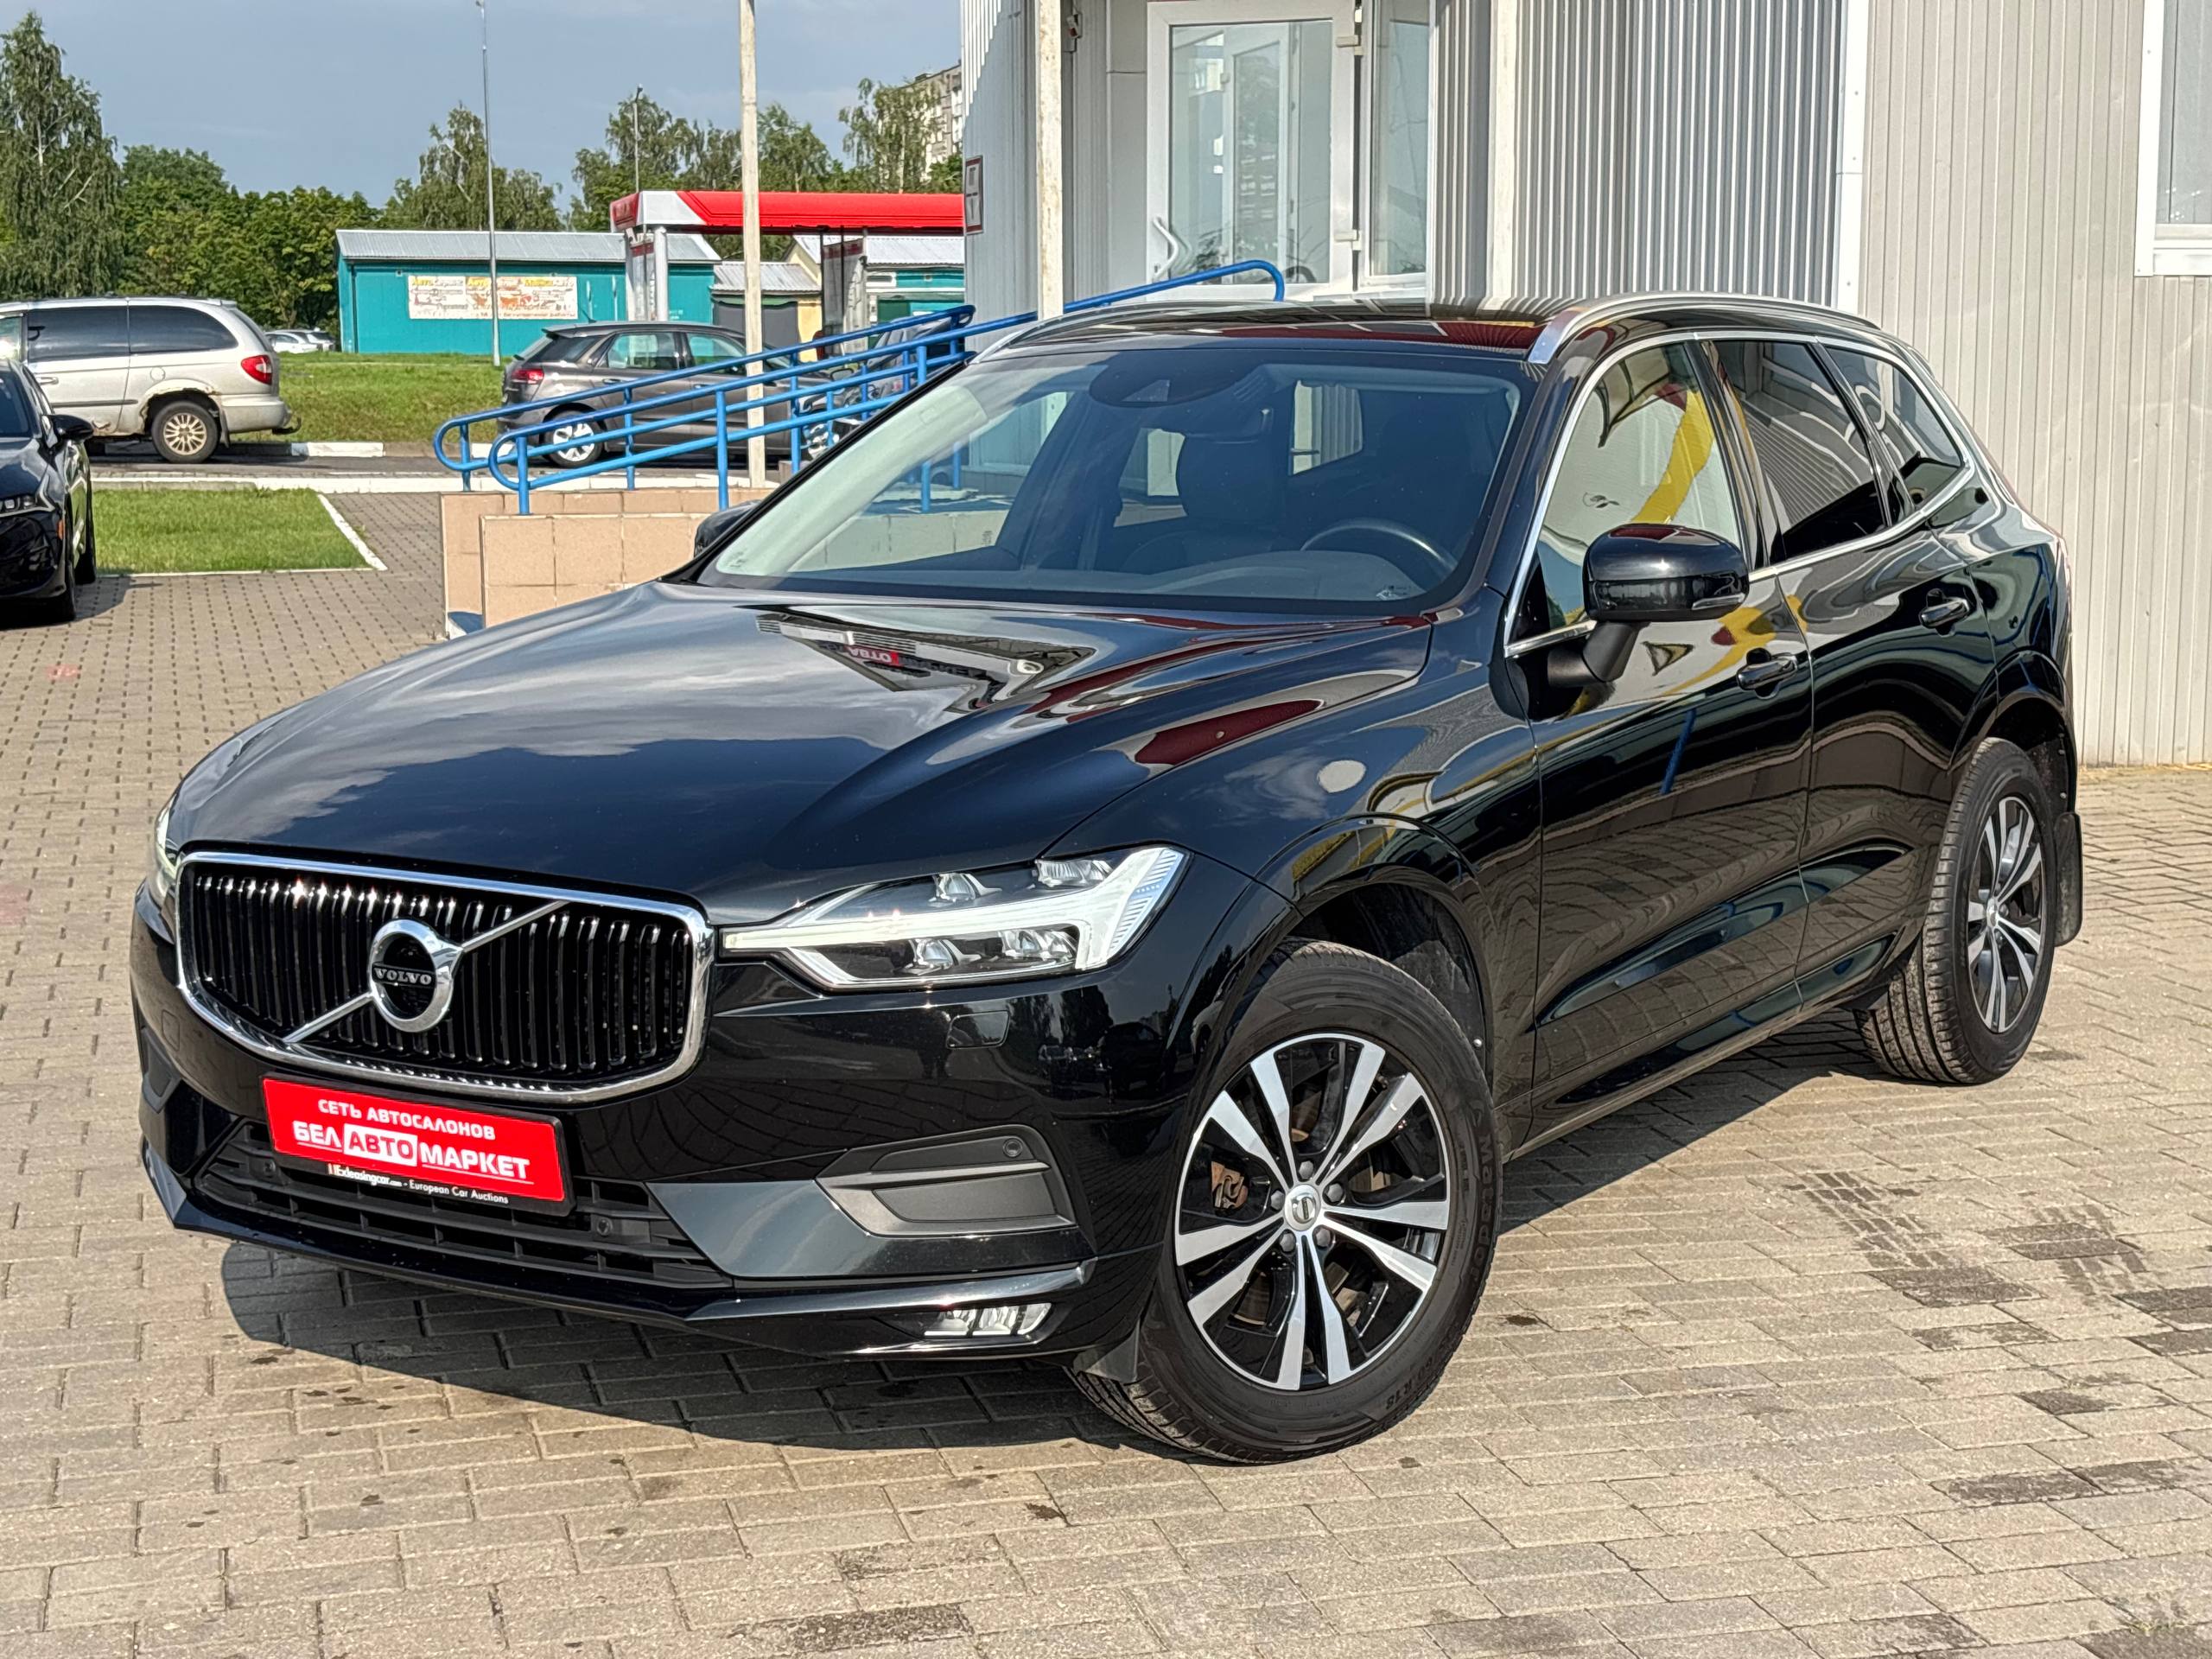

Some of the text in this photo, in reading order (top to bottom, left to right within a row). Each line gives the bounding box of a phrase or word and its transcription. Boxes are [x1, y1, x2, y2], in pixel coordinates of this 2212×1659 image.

[373, 968, 432, 985] VOLVO
[318, 1099, 495, 1140] СЕТЬ АВТОСАЛОНОВ
[409, 1179, 449, 1195] European
[452, 1185, 468, 1198] Car
[471, 1189, 508, 1205] Auctions
[1471, 1134, 1496, 1283] Matador
